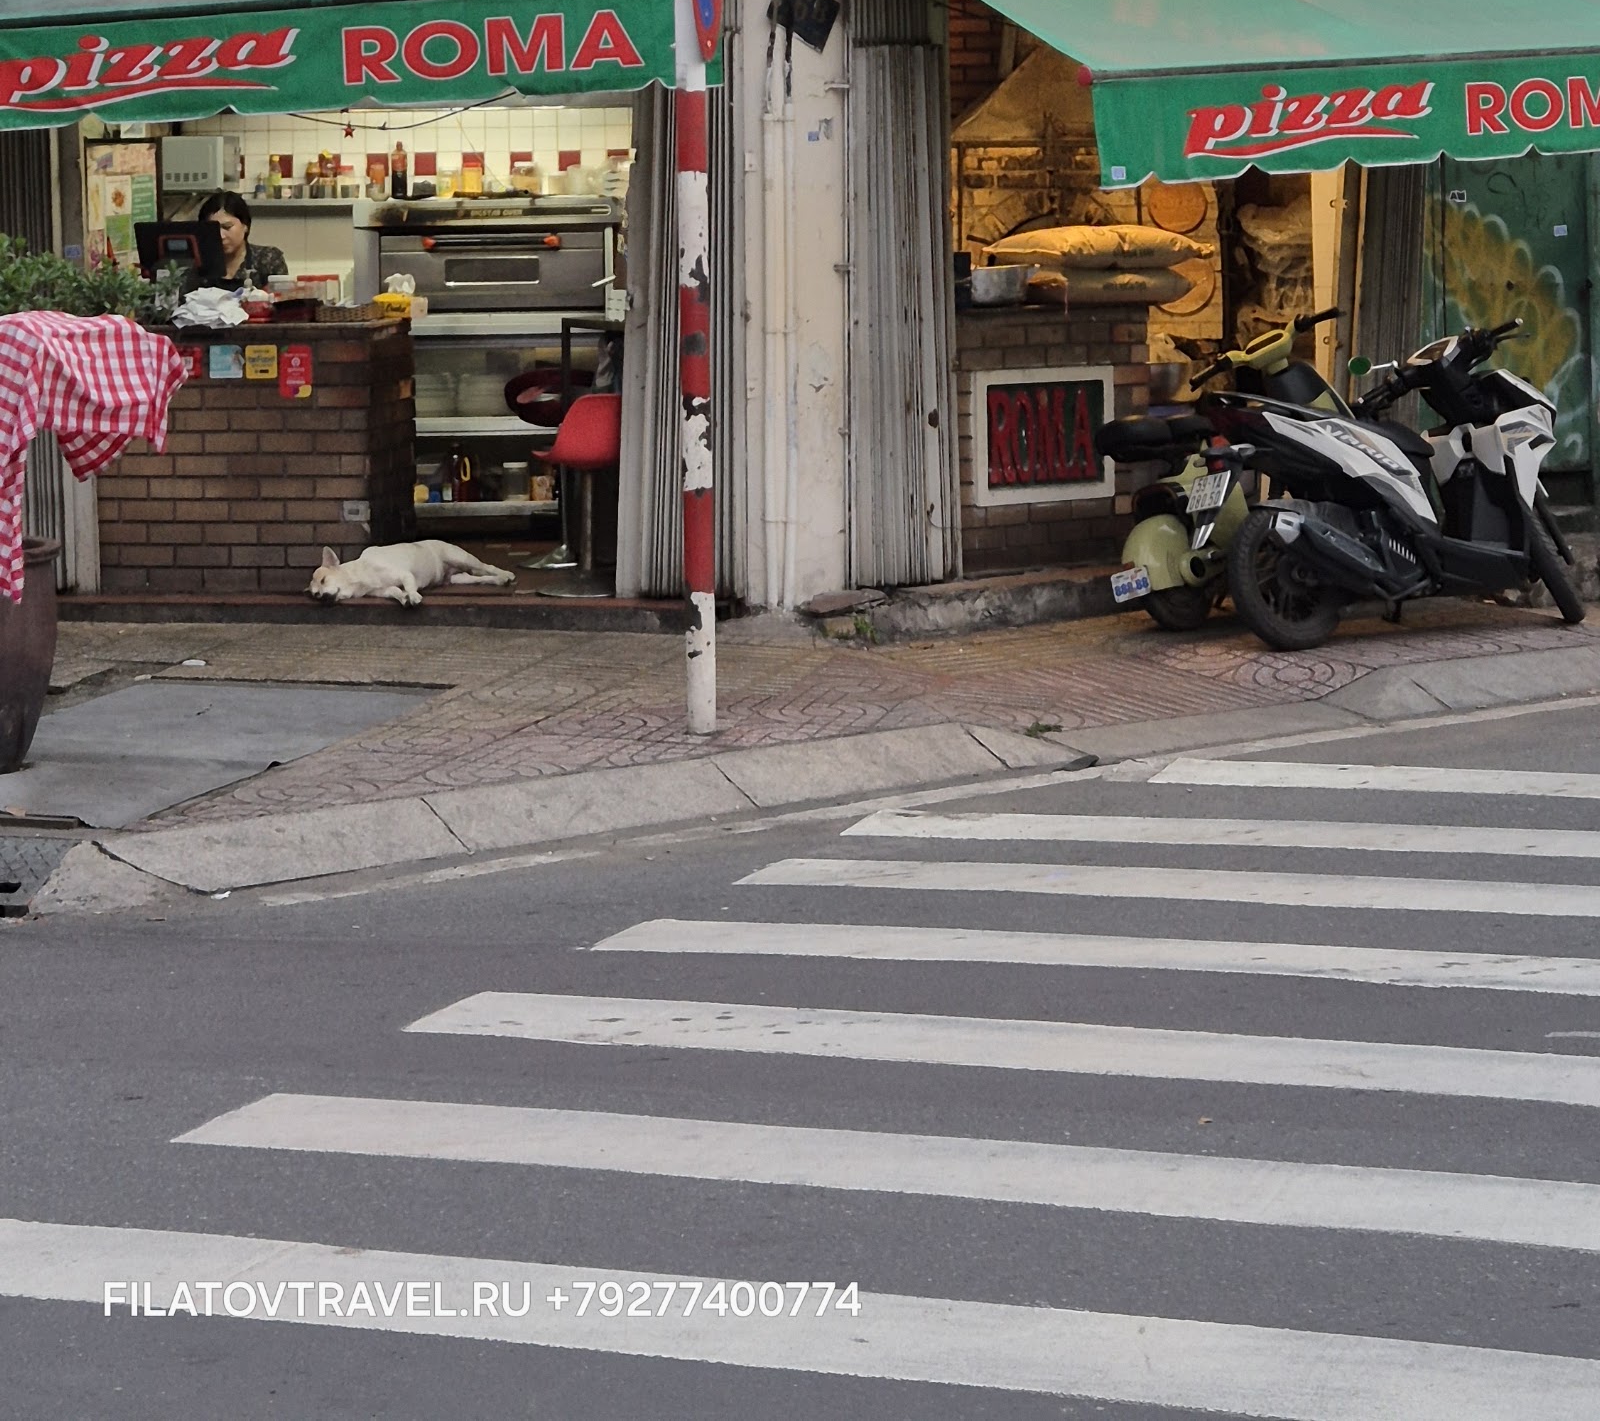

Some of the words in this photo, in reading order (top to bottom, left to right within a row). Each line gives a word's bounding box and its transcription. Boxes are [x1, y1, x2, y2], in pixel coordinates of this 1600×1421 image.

[0, 28, 301, 112] pizza
[342, 10, 644, 86] ROMA
[1184, 81, 1433, 159] pizza
[988, 386, 1097, 485] ROMA
[1325, 424, 1400, 470] VARIO
